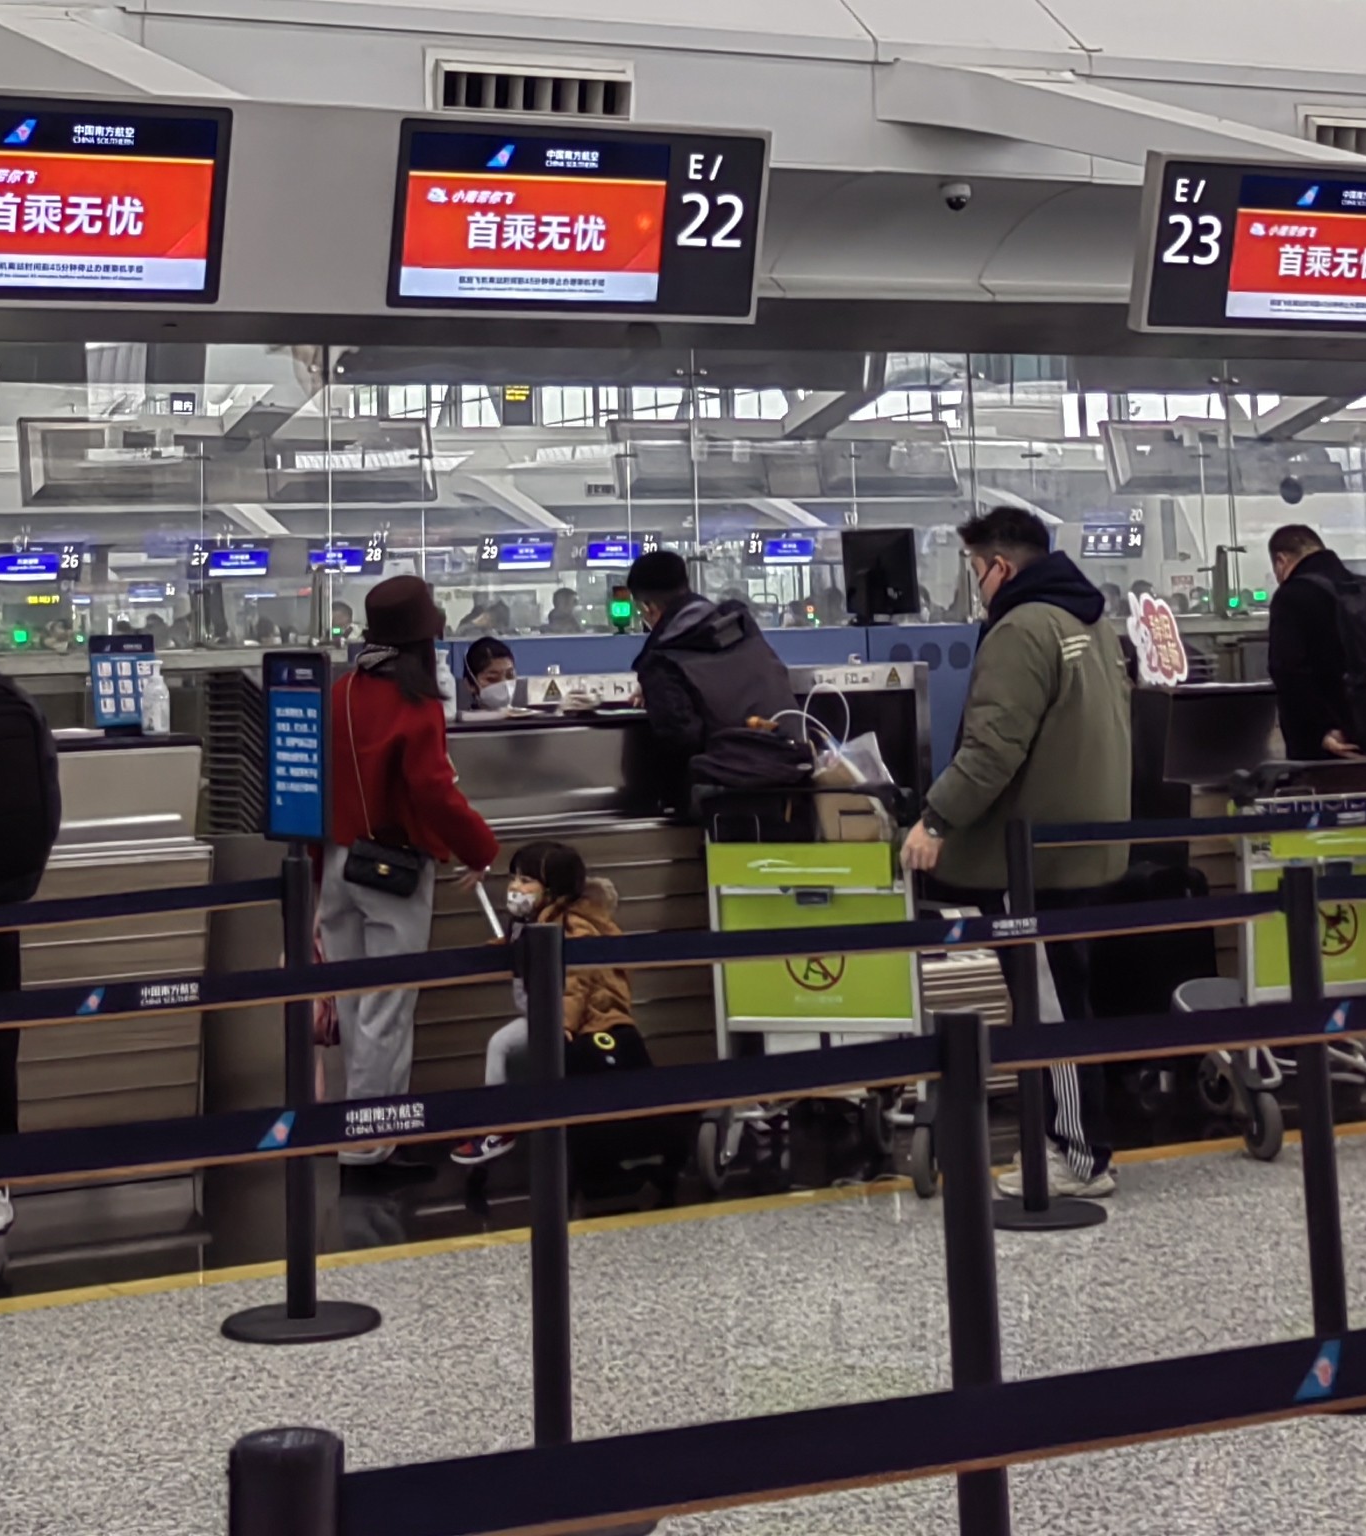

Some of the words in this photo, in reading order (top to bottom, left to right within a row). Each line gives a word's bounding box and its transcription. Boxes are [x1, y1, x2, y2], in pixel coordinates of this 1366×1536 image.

[73, 124, 135, 138] 中国南方航空
[676, 192, 744, 248] 22
[466, 211, 607, 252] 首乘无忧
[1162, 214, 1223, 265] 23
[365, 548, 382, 561] 28
[481, 545, 498, 559] 29
[748, 540, 762, 554] 31
[60, 554, 79, 569] 26
[345, 1102, 425, 1125] 中国南方航空
